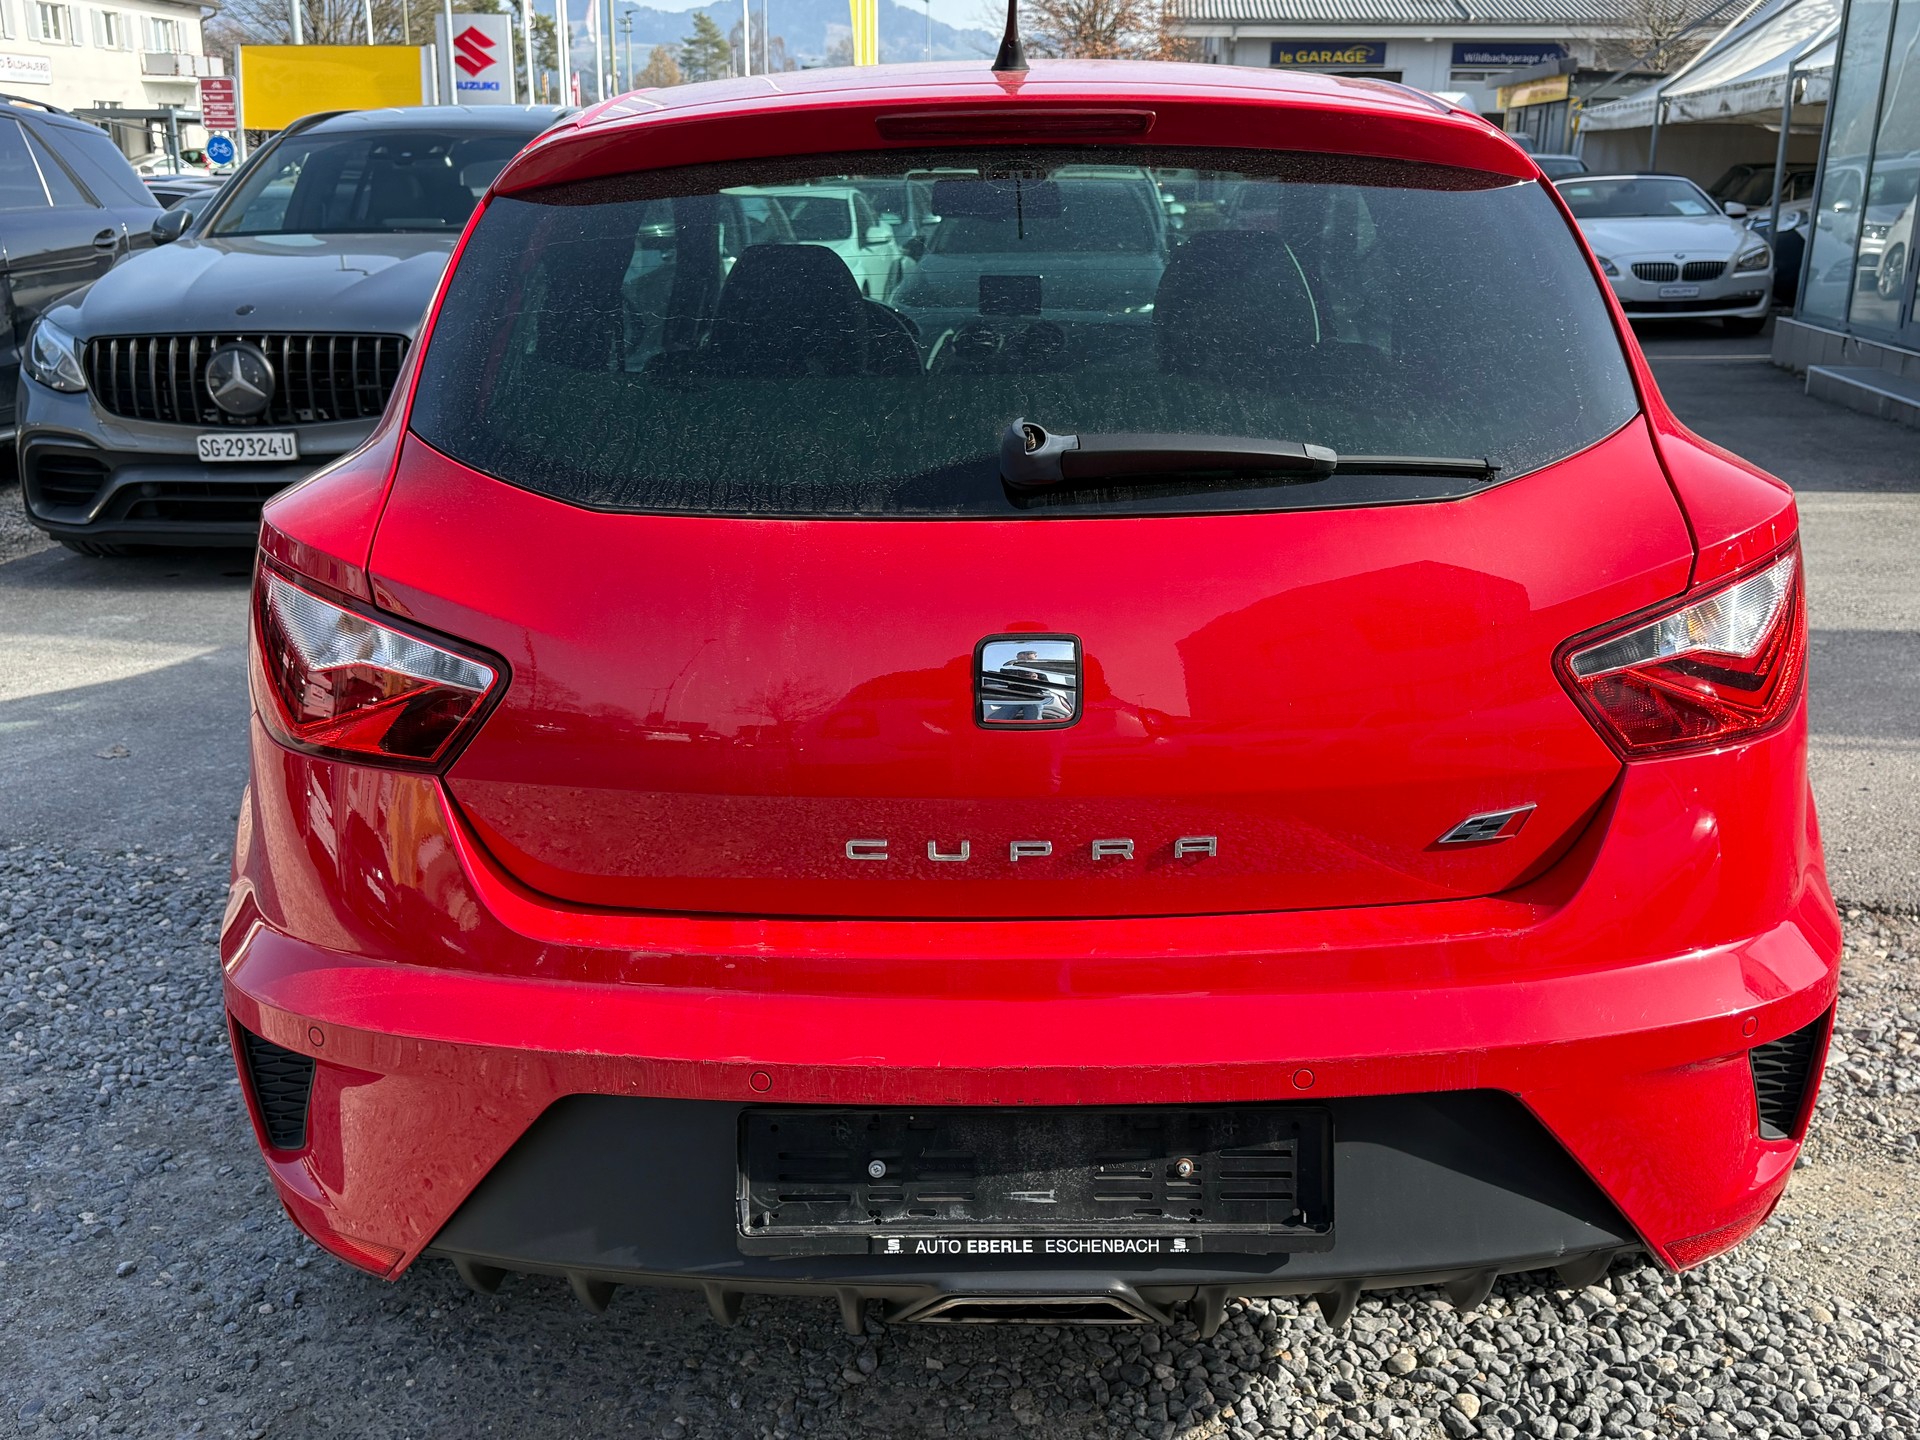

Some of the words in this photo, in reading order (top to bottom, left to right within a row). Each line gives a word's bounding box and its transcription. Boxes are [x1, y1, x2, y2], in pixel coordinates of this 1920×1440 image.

[1296, 50, 1368, 63] GARAGE
[1463, 52, 1539, 65] Wildbachgarage
[845, 836, 1218, 862] CUPRA
[915, 1239, 962, 1254] AUTO
[967, 1239, 1034, 1253] EBERLE
[1045, 1238, 1160, 1253] ESCHENBACH
